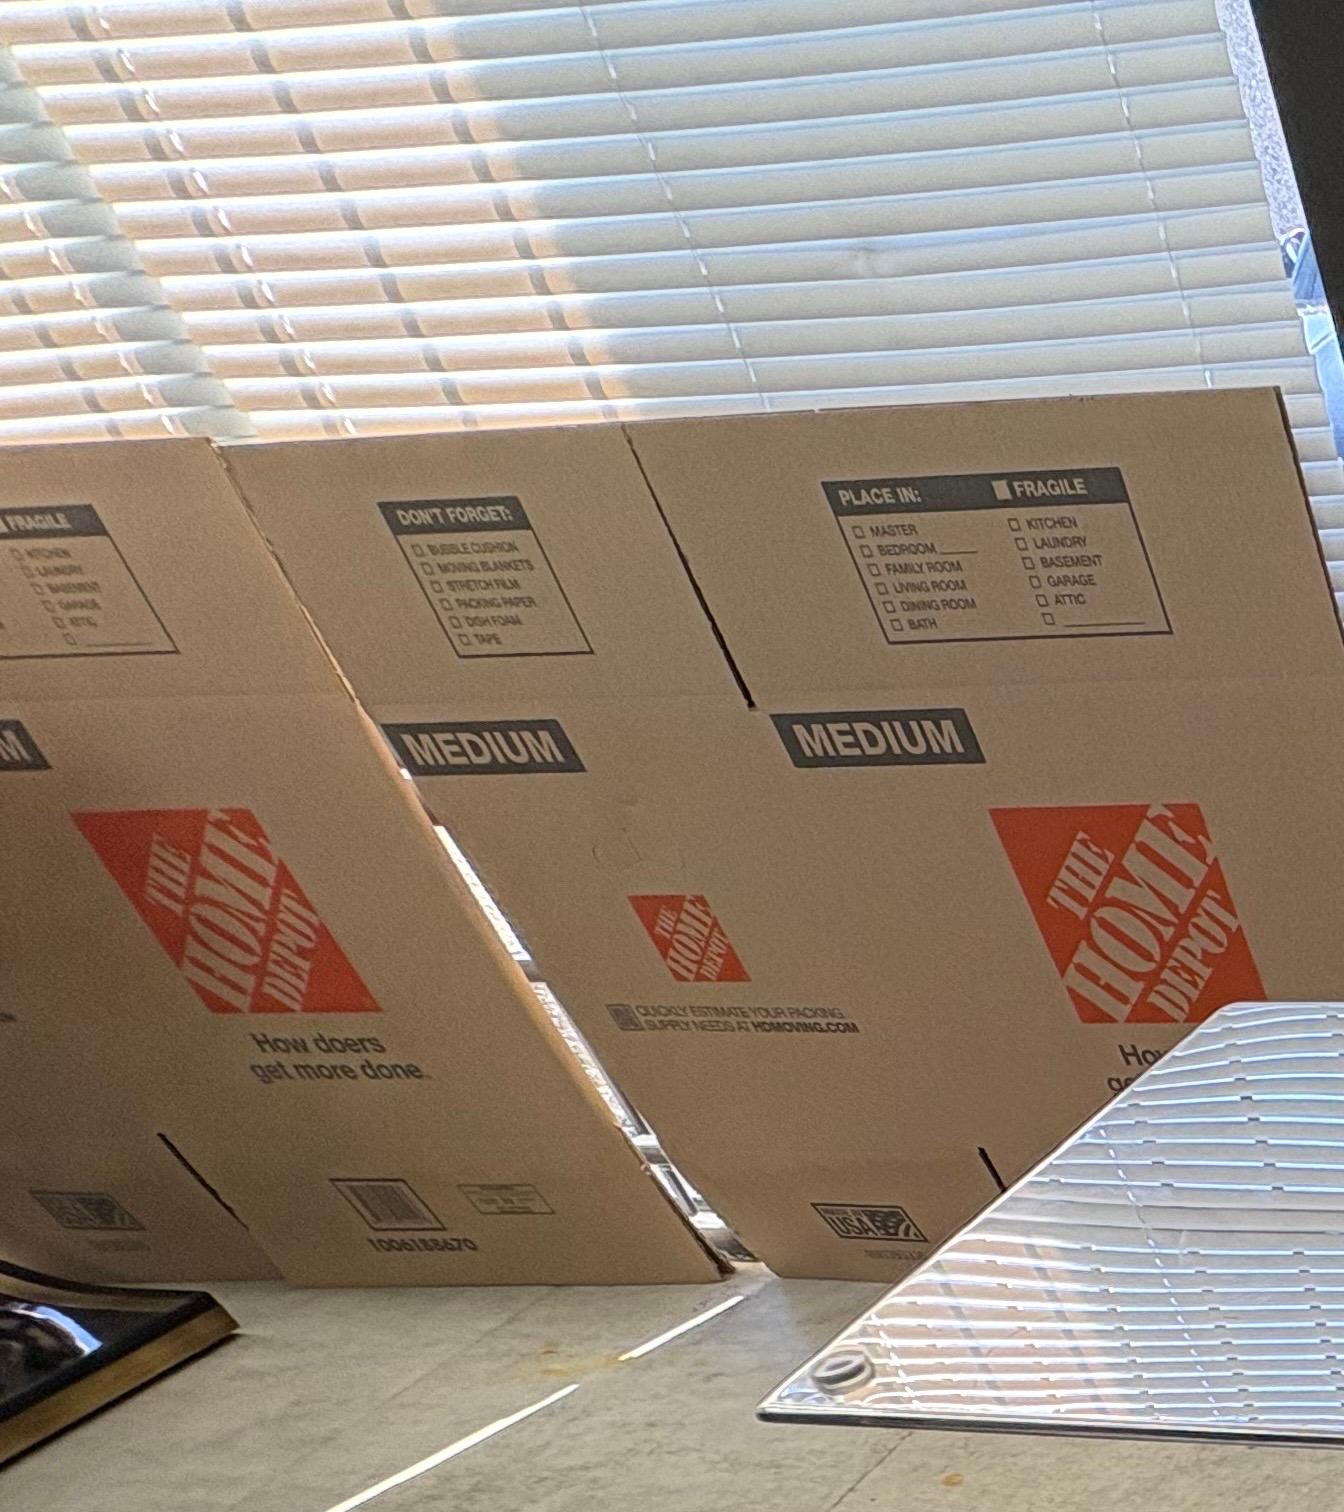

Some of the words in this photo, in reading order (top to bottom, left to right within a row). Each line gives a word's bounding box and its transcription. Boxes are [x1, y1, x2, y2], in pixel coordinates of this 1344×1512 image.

[838, 489, 895, 506] PLACE
[899, 487, 921, 503] IN:
[1013, 478, 1088, 498] FRAGILE
[7, 513, 71, 530] FRAGILE
[397, 507, 443, 525] DON'T
[448, 506, 513, 523] FORGET:
[1026, 516, 1077, 530] KITCHEN
[870, 524, 918, 537] MASTER
[877, 543, 937, 556] BEDROOM
[1033, 536, 1088, 549] LAUNDRY
[885, 563, 926, 575] FAMILY
[927, 561, 963, 573] ROOM
[1040, 555, 1103, 569] BASEMENT
[893, 582, 930, 594] LIVING
[933, 580, 967, 592] ROOM
[1047, 574, 1097, 587] GARAGE
[901, 600, 940, 612] DINING
[942, 598, 977, 610] ROOM
[1054, 594, 1087, 606] ATTIC
[908, 618, 937, 630] BATH
[792, 720, 965, 758] MEDIUM
[404, 730, 566, 768] MEDIUM
[145, 832, 192, 916] THE
[1045, 831, 1116, 920] THE
[185, 808, 281, 1013] HOME
[1065, 802, 1217, 1021] HOME
[653, 904, 676, 940] THE
[667, 896, 714, 982] HOME
[261, 889, 321, 1012] DEPOT
[700, 926, 731, 982] DEPOT
[1146, 889, 1239, 1022] DEPOT
[691, 1005, 750, 1017] ESTIMATE
[750, 1006, 788, 1018] YOUR
[250, 1032, 308, 1054] How
[313, 1032, 386, 1054] doers
[250, 1060, 289, 1085] get
[296, 1061, 358, 1080] more
[828, 1216, 878, 1236] USA
